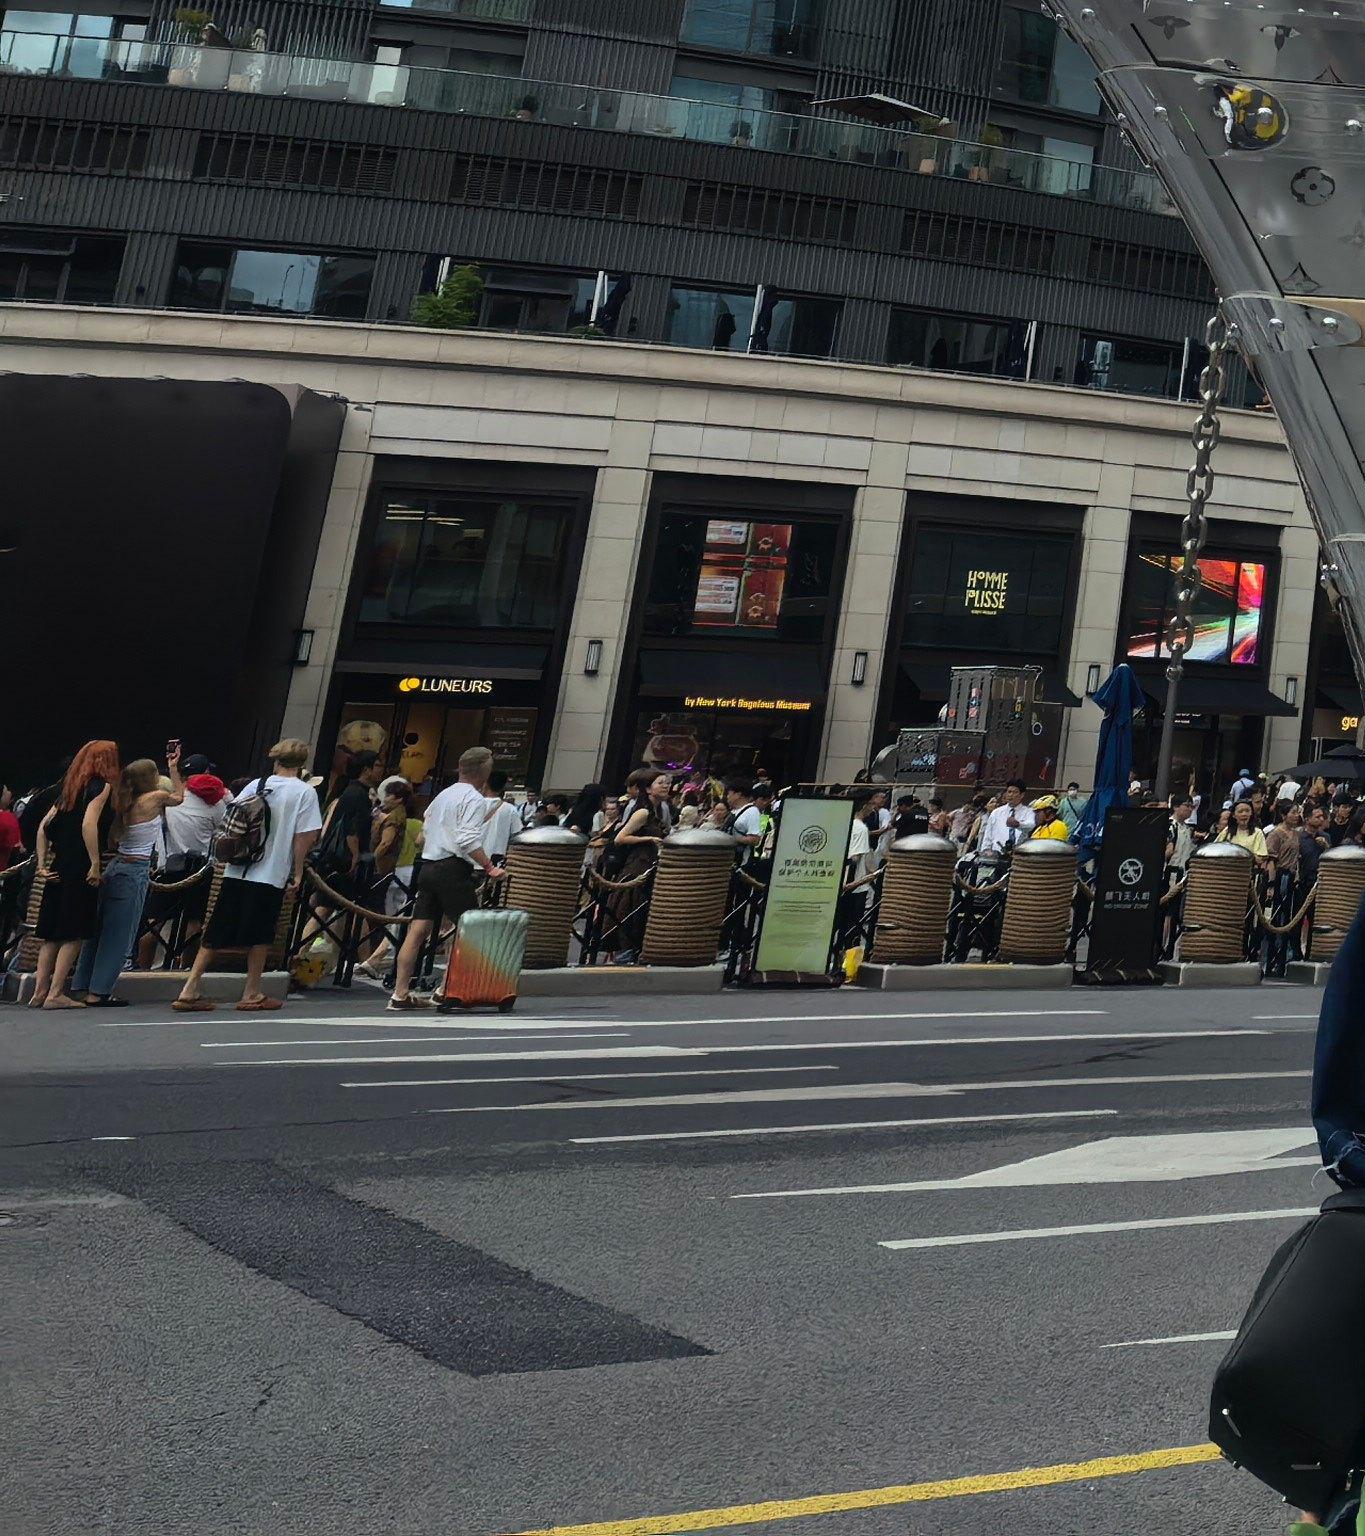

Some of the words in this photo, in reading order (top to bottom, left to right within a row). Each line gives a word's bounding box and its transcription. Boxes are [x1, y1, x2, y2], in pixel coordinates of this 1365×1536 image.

[421, 678, 493, 693] LUNEURS
[684, 697, 694, 708] by
[696, 697, 715, 707] New
[716, 698, 736, 708] York
